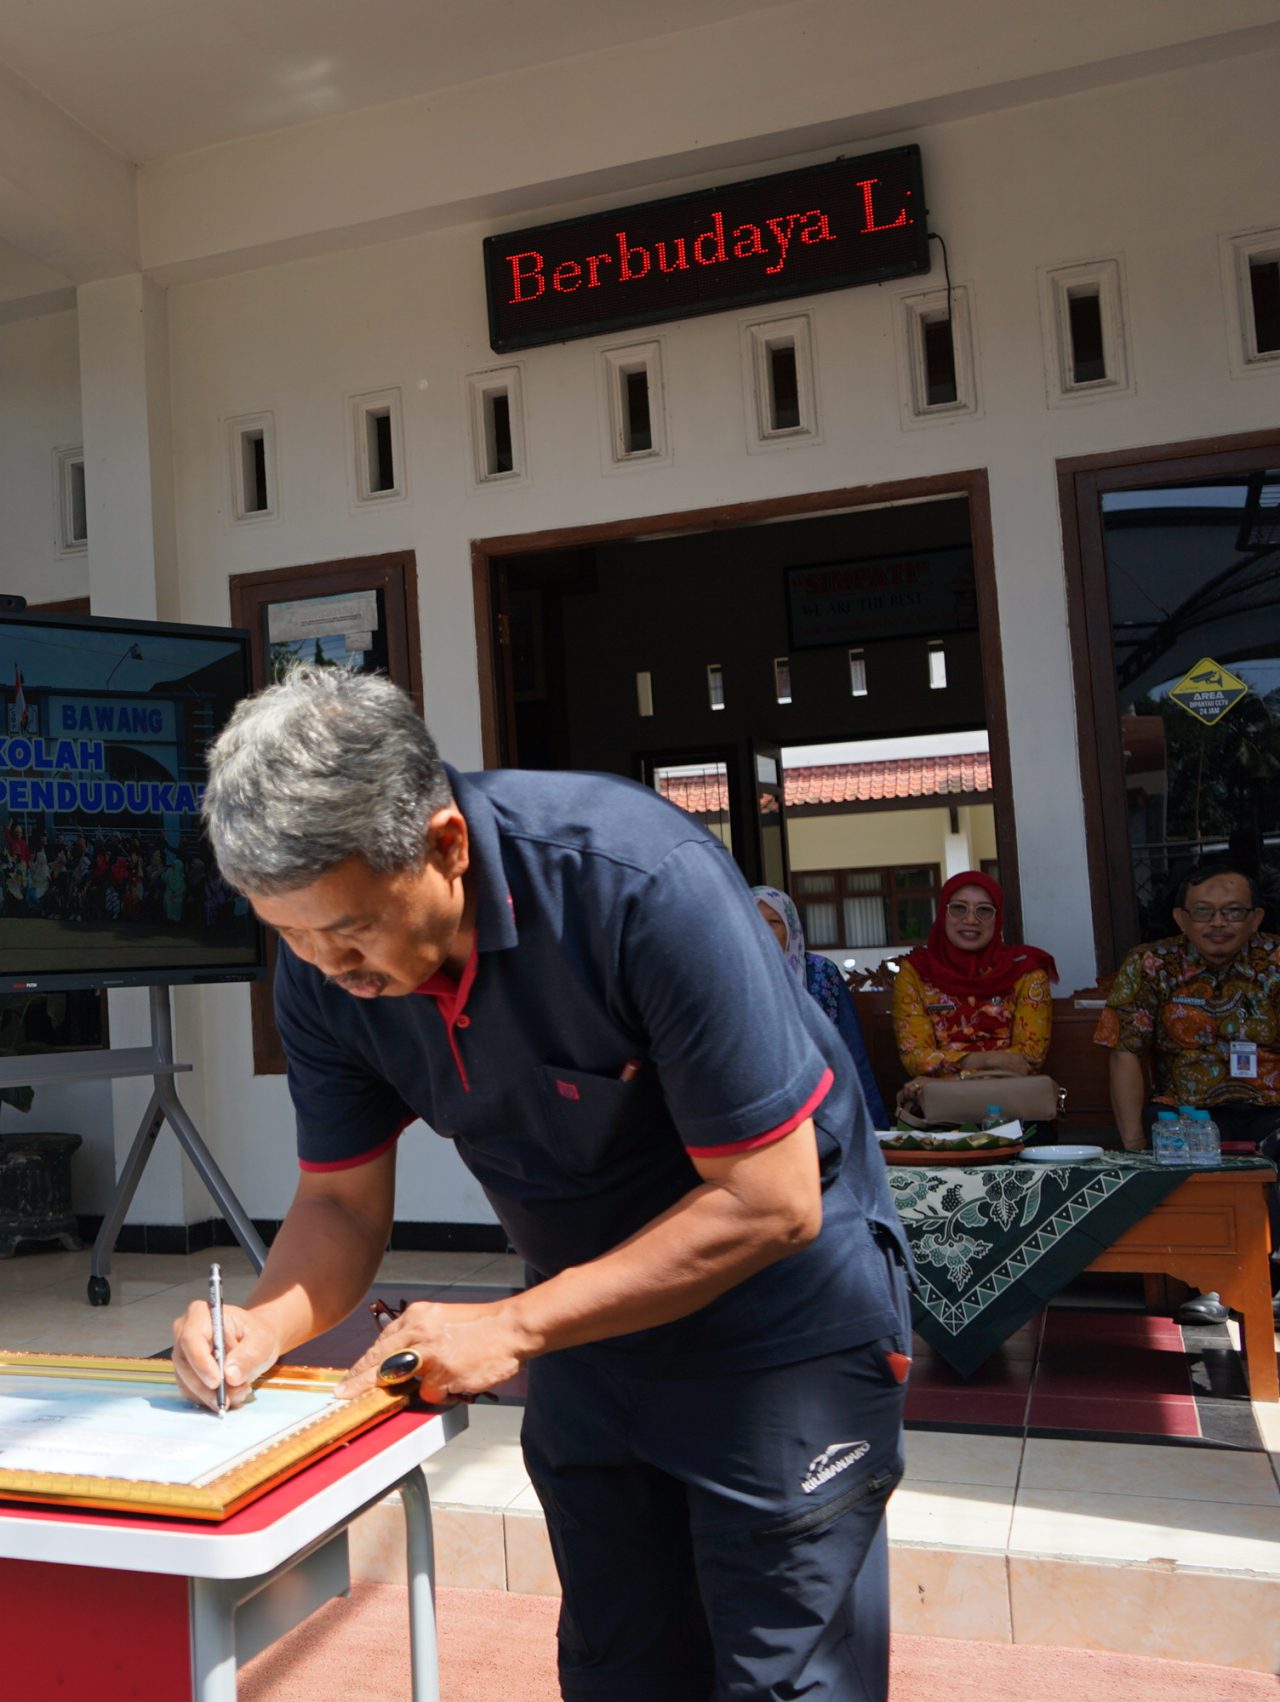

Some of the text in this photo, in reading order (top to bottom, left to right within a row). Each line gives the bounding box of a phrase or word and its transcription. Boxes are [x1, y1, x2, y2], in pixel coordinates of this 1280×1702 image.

[506, 178, 915, 304] Berbudaya L
[1193, 691, 1225, 700] AREA
[61, 703, 163, 734] BAWANG
